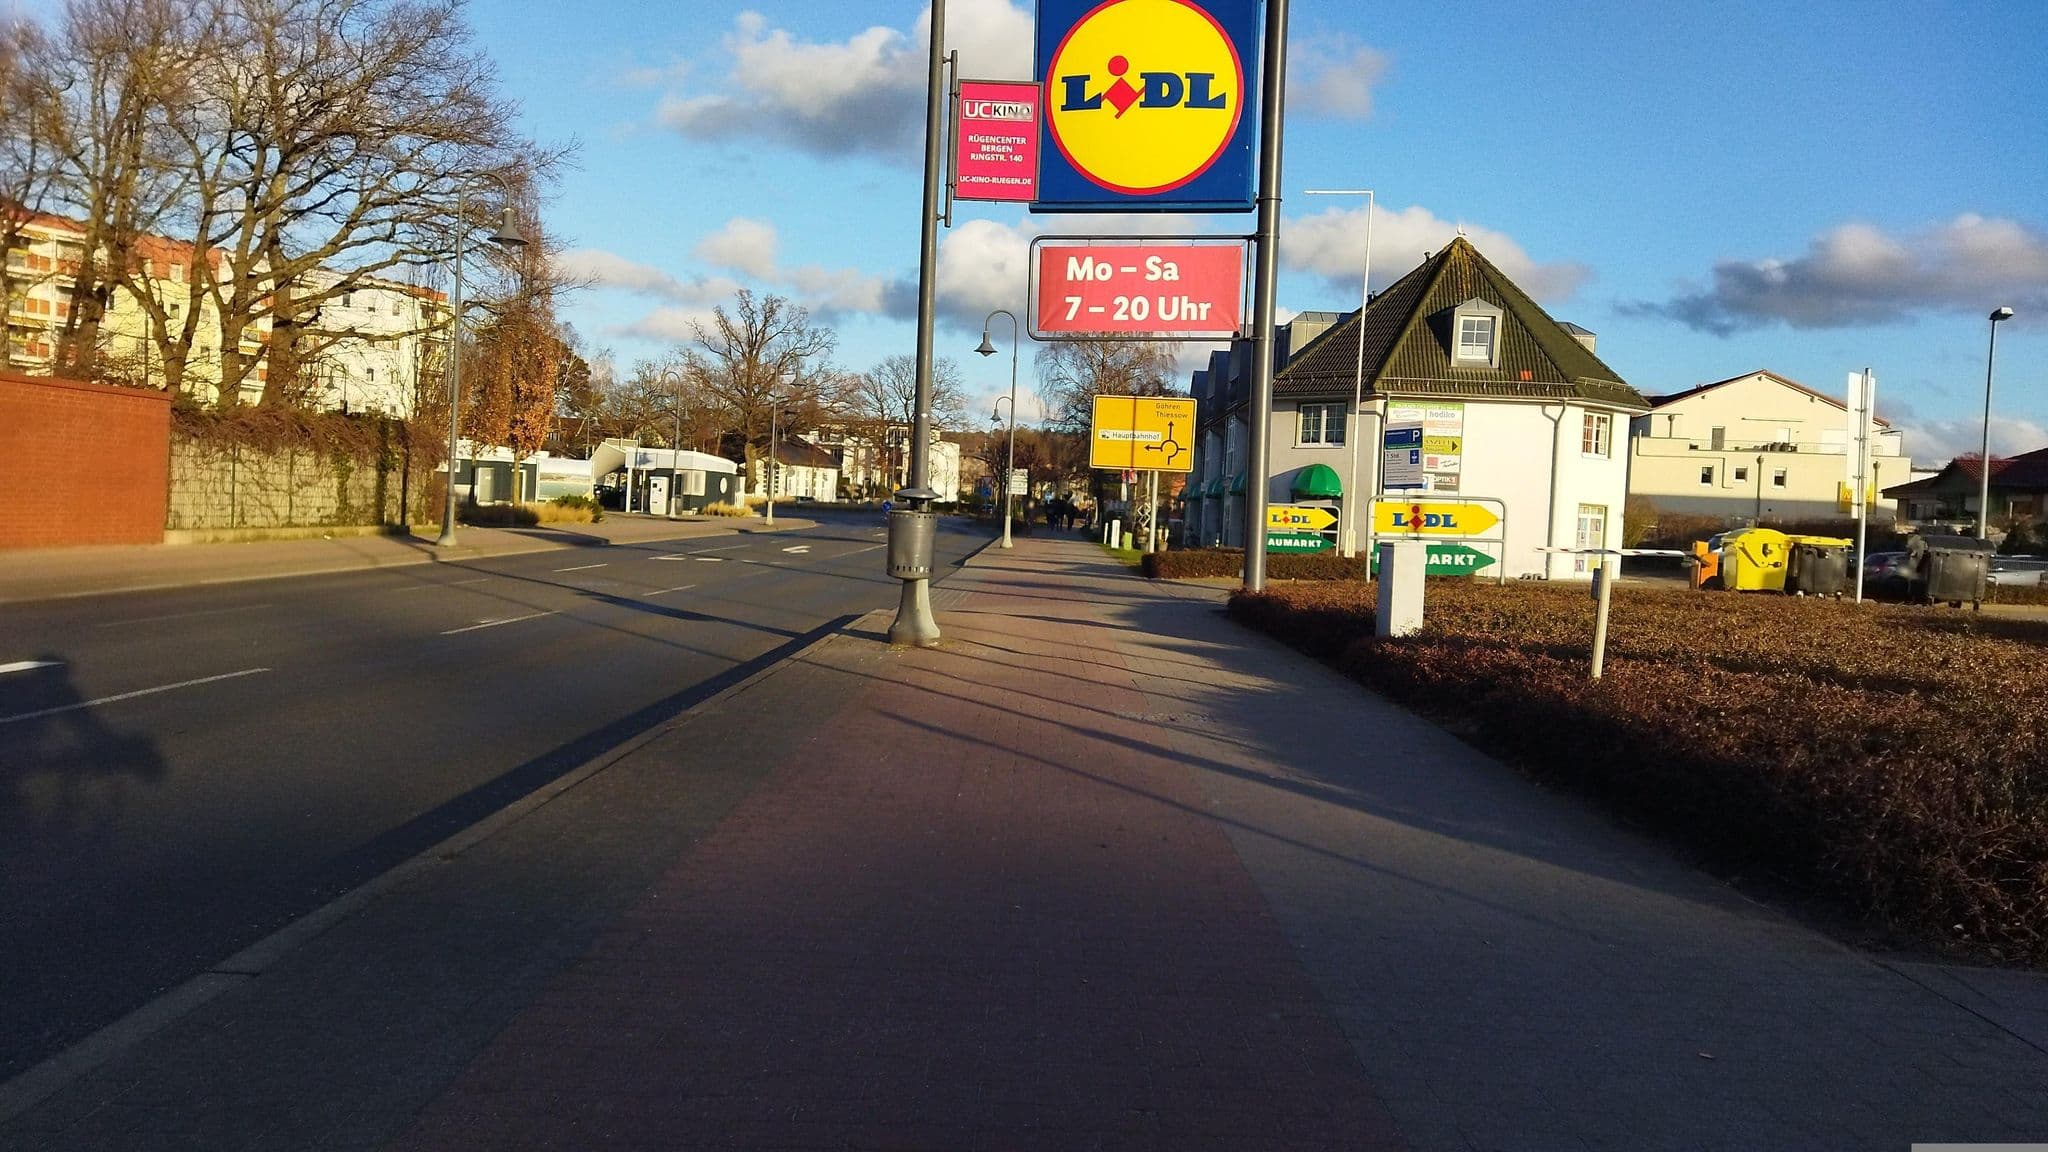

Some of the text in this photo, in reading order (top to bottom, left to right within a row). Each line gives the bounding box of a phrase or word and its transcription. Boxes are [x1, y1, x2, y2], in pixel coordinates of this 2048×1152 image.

[968, 133, 1027, 145] RÜGENCENTER
[981, 145, 1013, 153] BERGEN
[970, 153, 1023, 163] RINGSTR. 140
[960, 175, 1032, 185] UC-KINO-RUEGEN.DE
[1066, 256, 1113, 281] Mo
[1145, 255, 1180, 281] Sa
[1064, 296, 1083, 321] 7
[1112, 296, 1150, 321] 20
[1157, 296, 1212, 321] Uhr
[1156, 411, 1189, 419] Thiessow
[1112, 431, 1160, 440] Hauptbahnhof
[1412, 430, 1420, 442] P
[1268, 538, 1322, 548] AUMARKT
